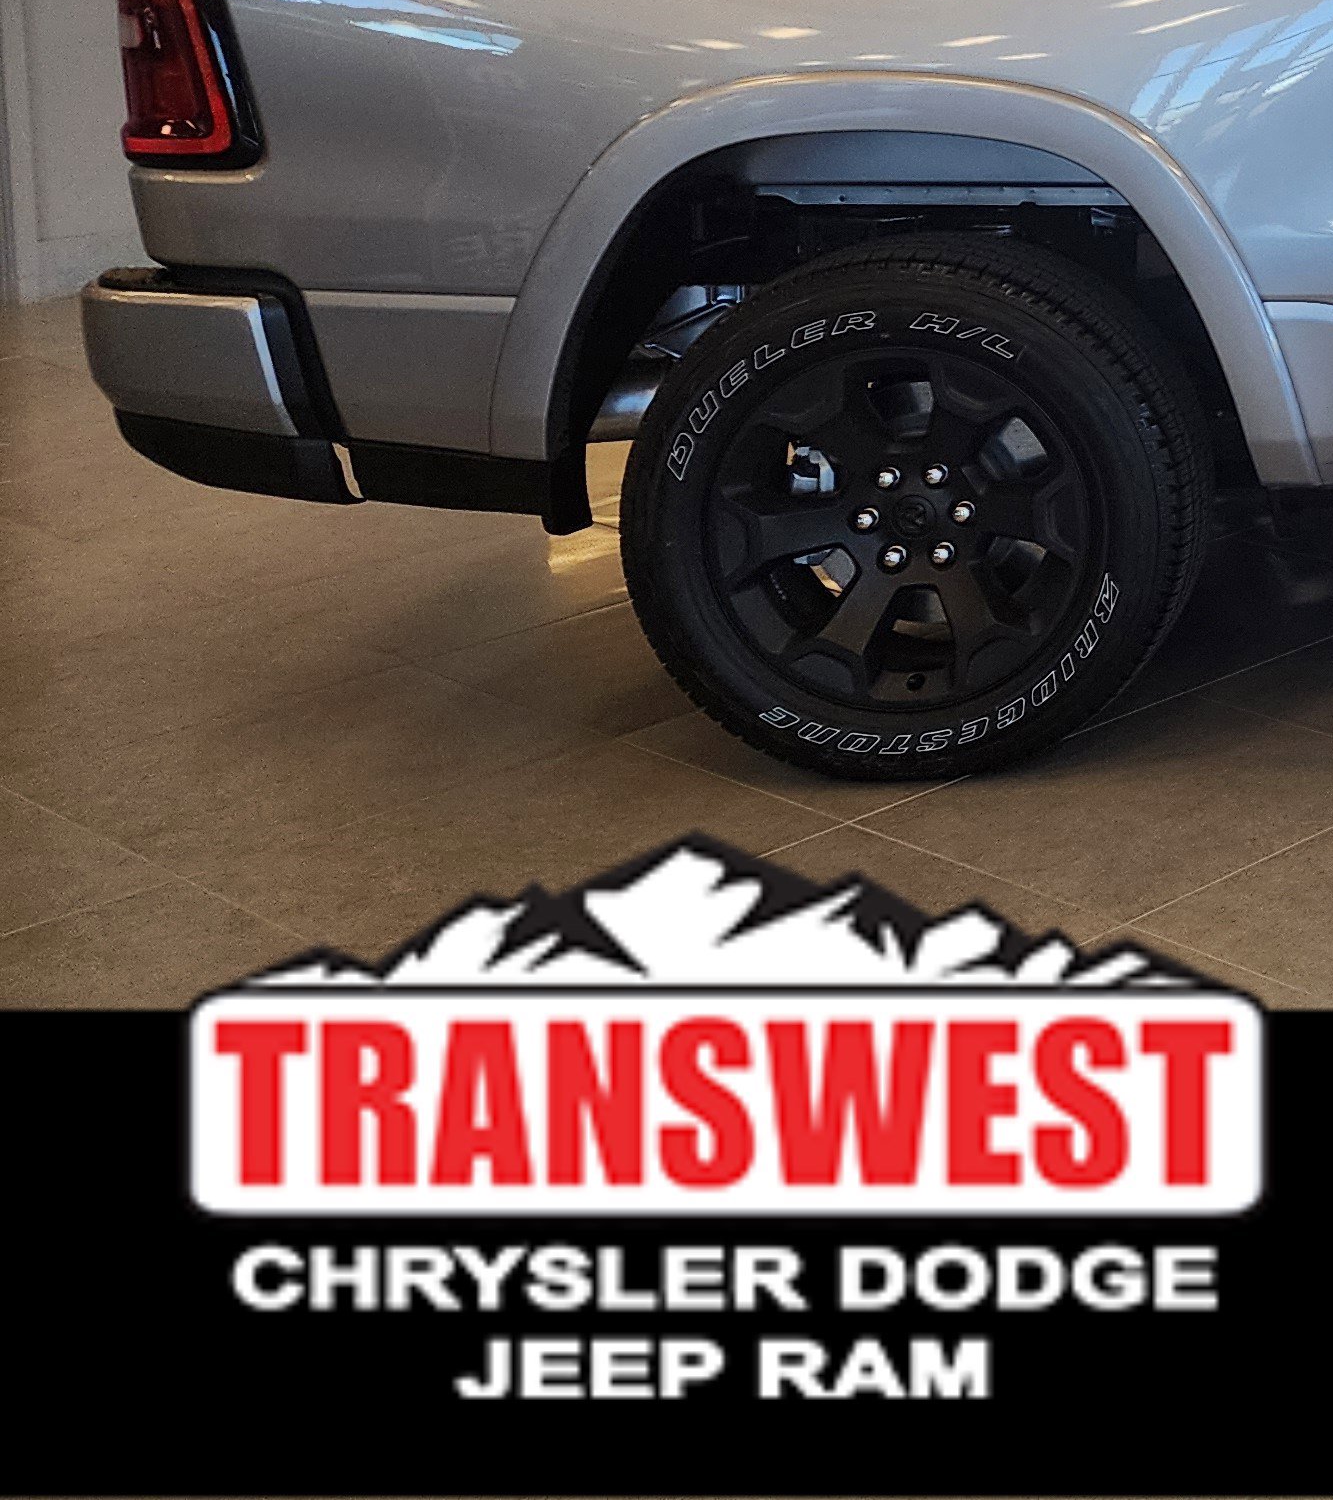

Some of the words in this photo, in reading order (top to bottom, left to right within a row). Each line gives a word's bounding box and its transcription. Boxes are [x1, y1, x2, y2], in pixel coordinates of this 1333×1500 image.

[666, 310, 876, 481] DUELER
[909, 312, 1017, 359] H/L
[759, 572, 1120, 756] BRIDGESTONE
